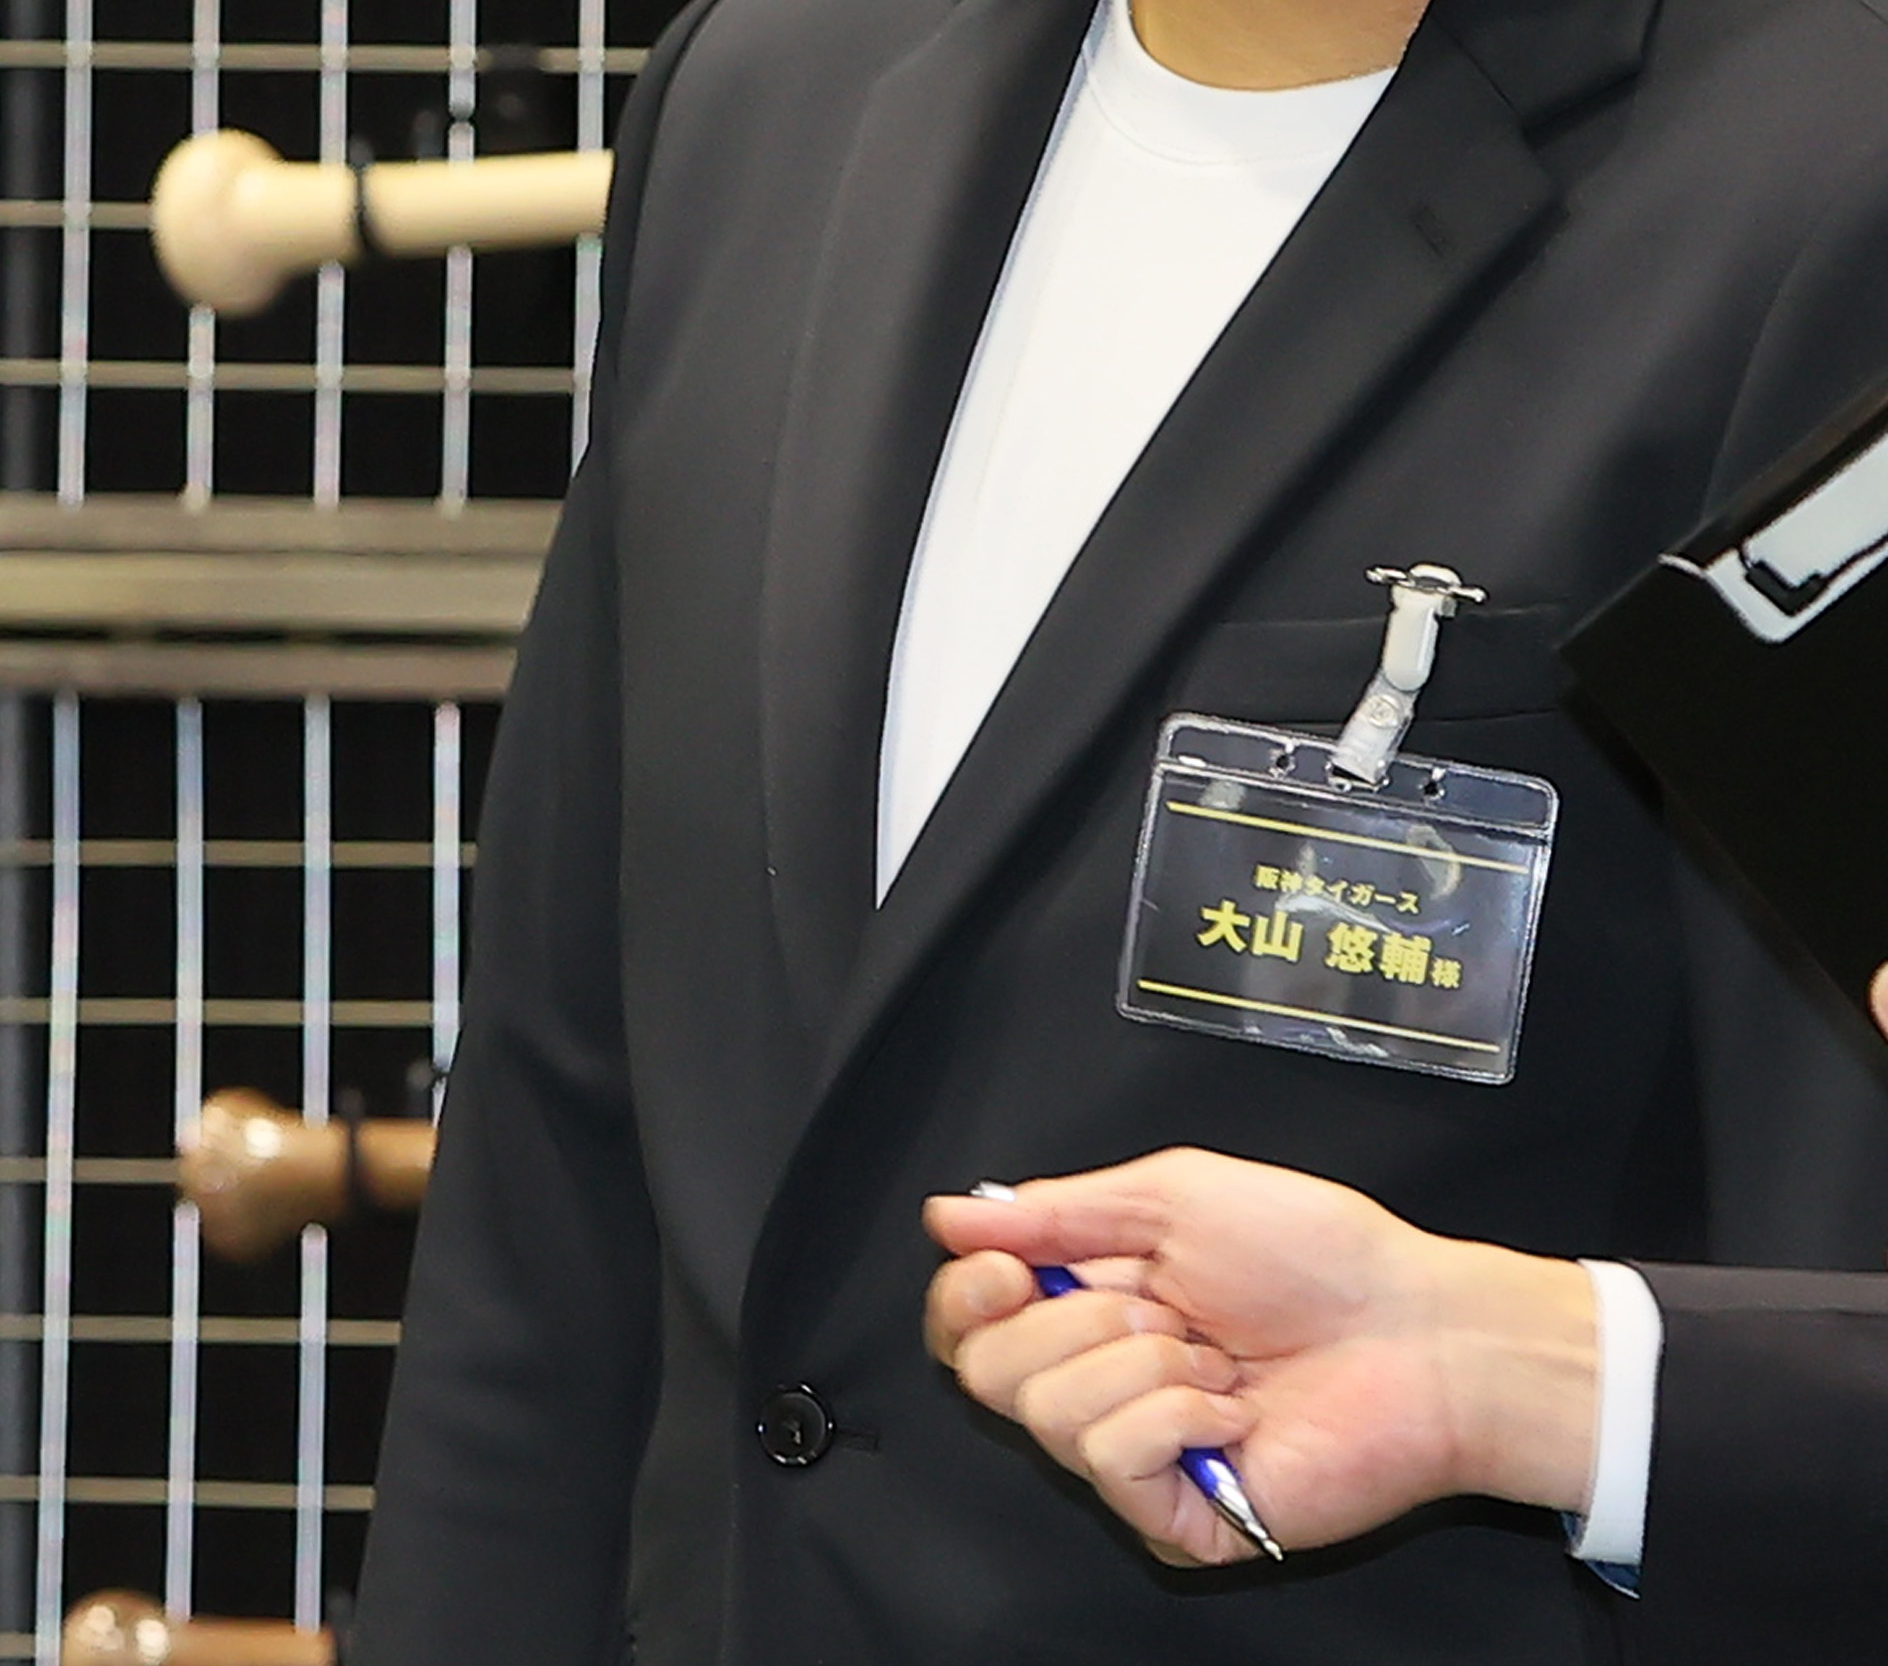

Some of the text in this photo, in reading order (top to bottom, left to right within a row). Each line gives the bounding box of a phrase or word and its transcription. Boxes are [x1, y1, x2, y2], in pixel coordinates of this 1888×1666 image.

[1255, 864, 1420, 915] 阪神タイガース
[1197, 899, 1304, 963] 大山
